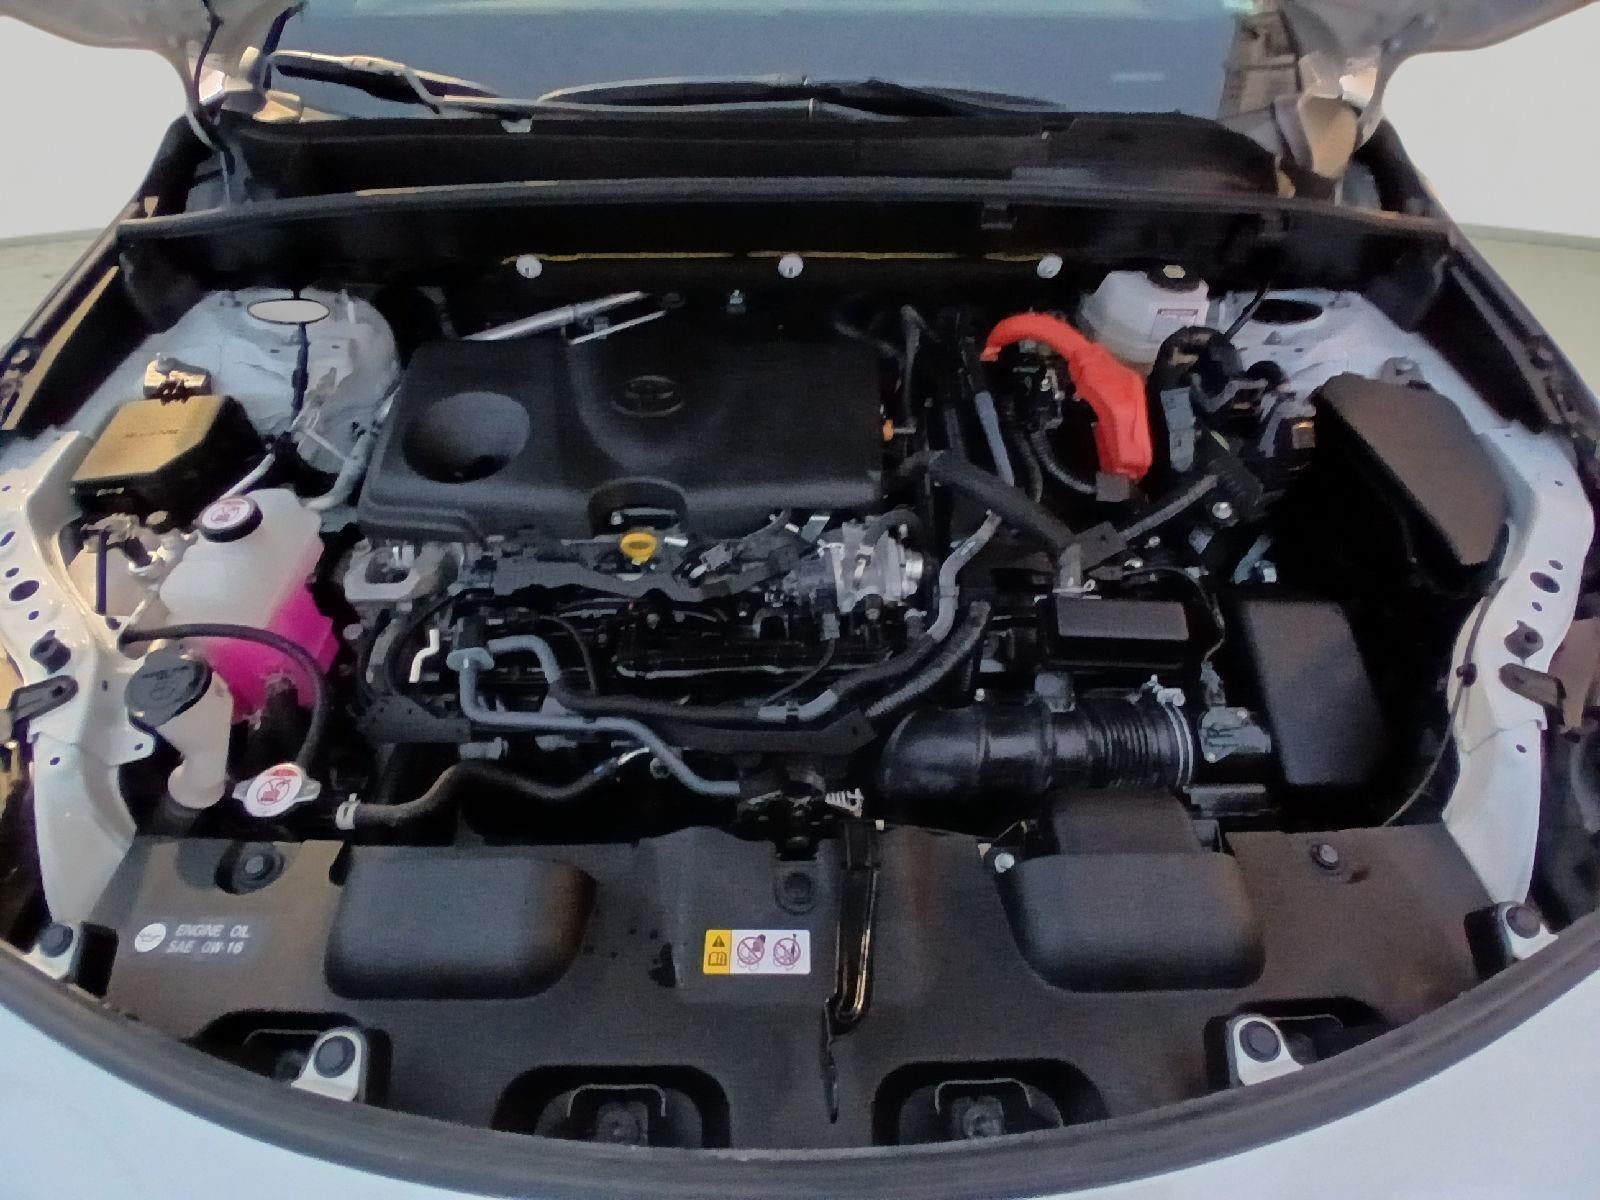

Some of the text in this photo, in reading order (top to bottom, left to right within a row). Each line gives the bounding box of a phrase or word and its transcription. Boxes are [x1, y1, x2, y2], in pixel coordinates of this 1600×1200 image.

[175, 924, 250, 938] ENGINE OIL
[167, 940, 195, 953] SAE
